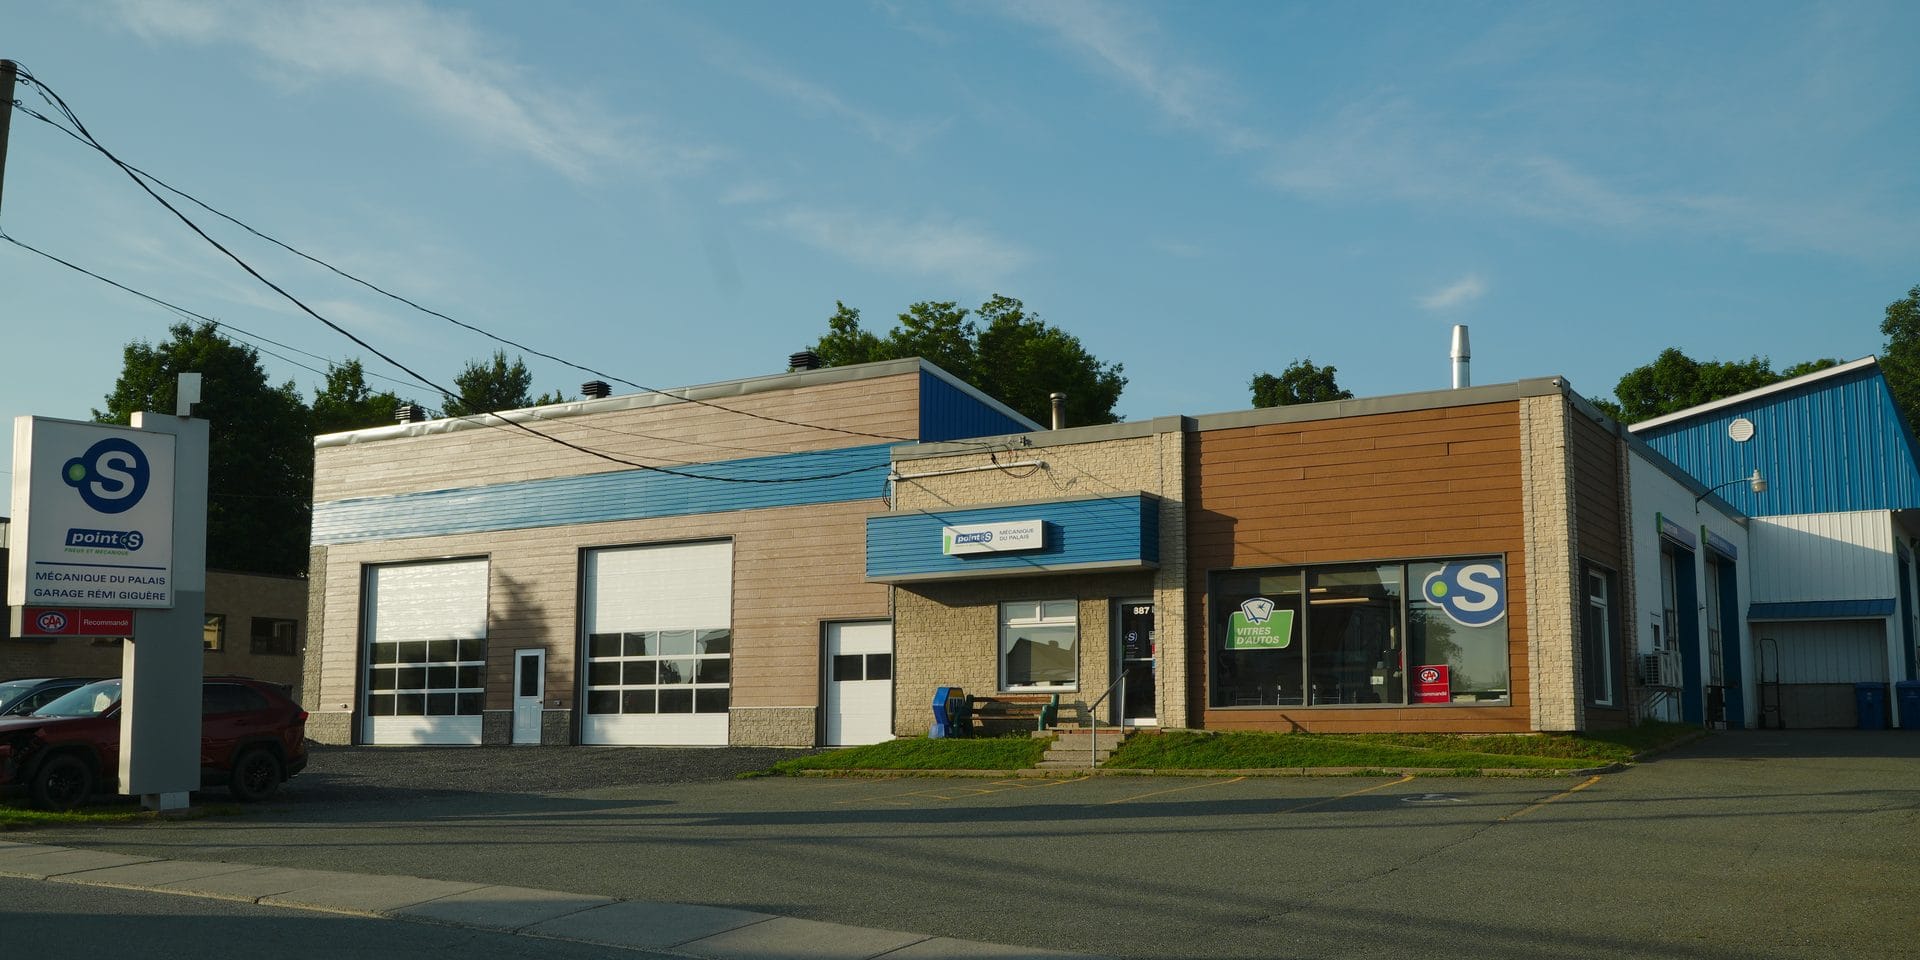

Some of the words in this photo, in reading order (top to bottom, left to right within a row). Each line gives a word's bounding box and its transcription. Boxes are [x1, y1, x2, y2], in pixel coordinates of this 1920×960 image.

[90, 451, 137, 500] S
[72, 531, 119, 545] point
[127, 533, 141, 548] S
[958, 534, 980, 543] point
[985, 532, 992, 541] S
[35, 571, 107, 583] MÉCANIQUE
[110, 574, 125, 583] DU
[128, 576, 166, 585] PALAIS
[1452, 564, 1501, 612] S
[34, 588, 84, 598] GARAGE
[87, 588, 116, 599] RÉMI
[119, 589, 166, 600] GIGUÈRE
[42, 615, 61, 626] CAA
[84, 618, 129, 626] Recommandé
[1237, 627, 1271, 636] VITRES
[1236, 636, 1279, 645] D'AUTOS
